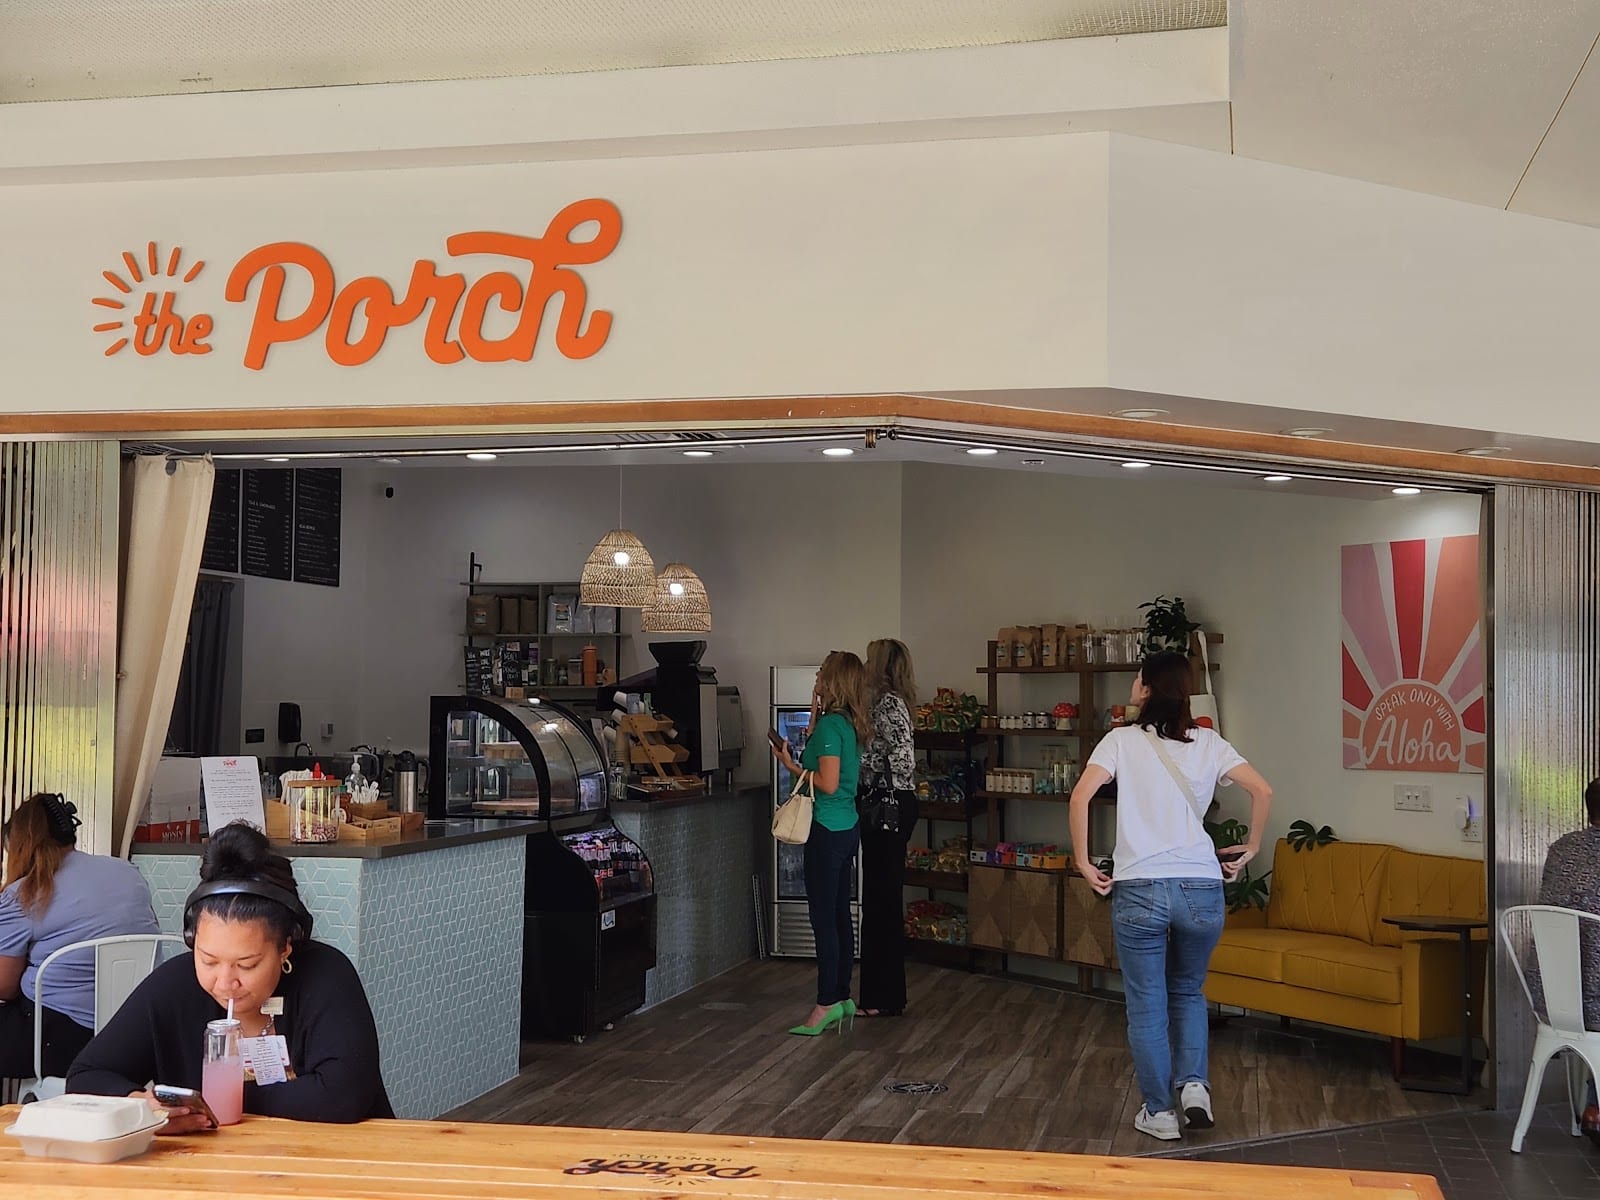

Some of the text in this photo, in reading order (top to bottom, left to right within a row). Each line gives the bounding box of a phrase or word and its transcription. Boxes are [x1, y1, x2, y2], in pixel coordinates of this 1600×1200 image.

[133, 198, 623, 370] the Porch
[1375, 688, 1455, 731] SPEAK ONLY WITH
[1363, 715, 1461, 765] Aloha
[562, 1158, 762, 1179] Porch
